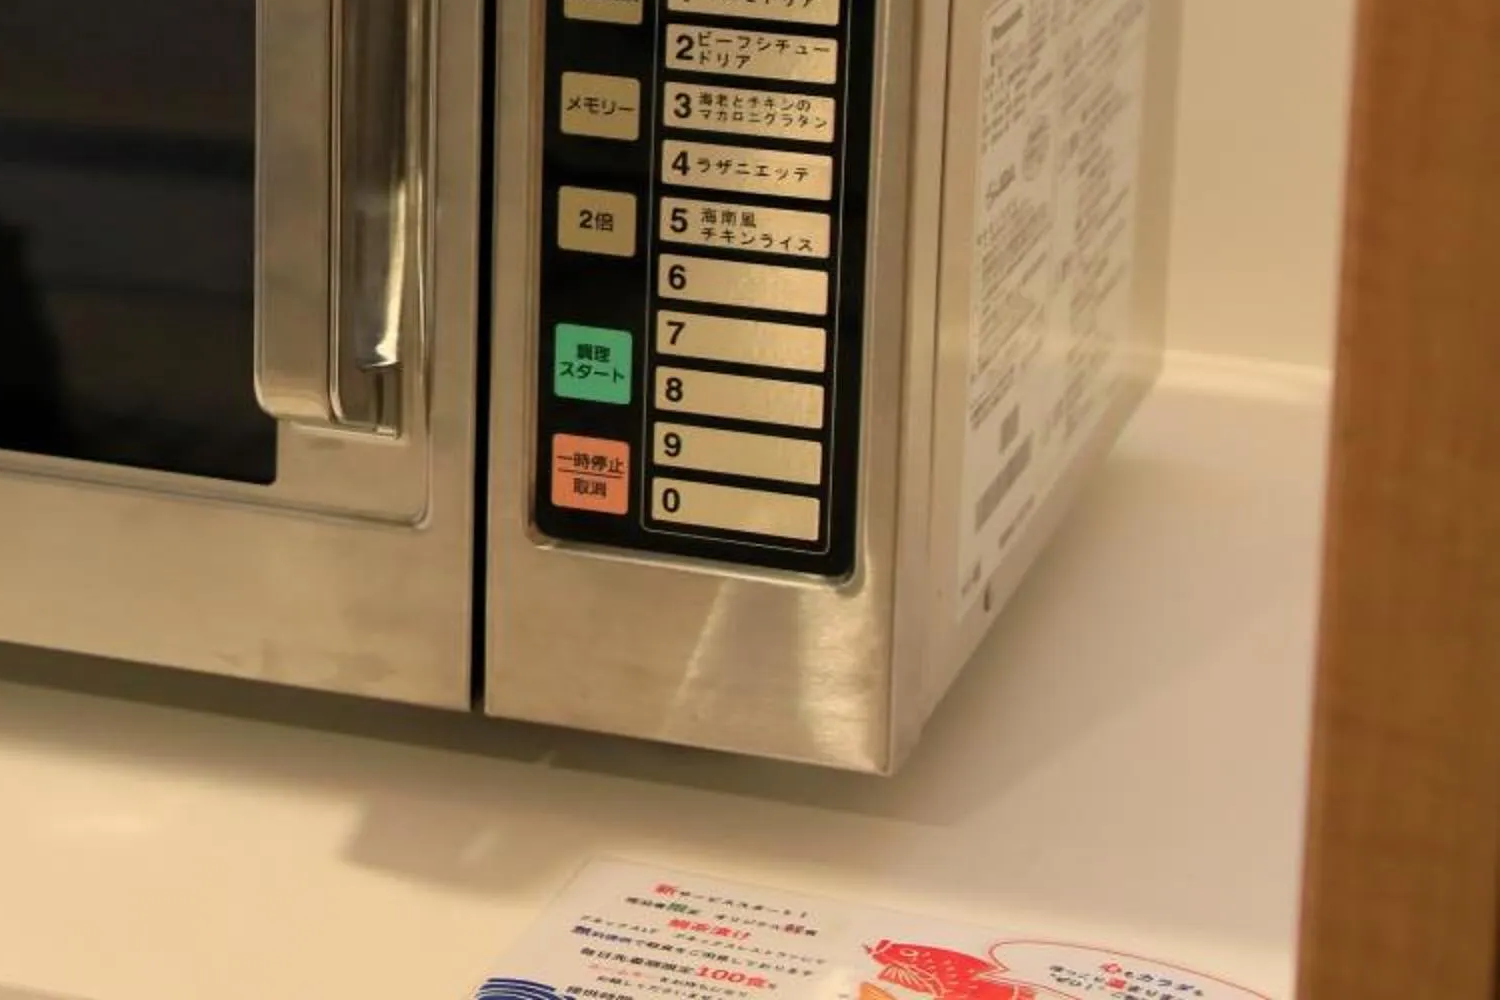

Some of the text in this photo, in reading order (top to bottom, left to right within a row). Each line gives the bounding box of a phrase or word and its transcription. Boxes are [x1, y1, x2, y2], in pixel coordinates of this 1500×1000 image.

[675, 31, 831, 61] 2 ビーフシチュー
[699, 51, 751, 68] ドリア
[566, 96, 636, 116] メモリー
[673, 92, 692, 119] 3
[699, 109, 828, 130] マカロニグラタン
[672, 151, 809, 182] 4 ラザニエッテ
[579, 209, 614, 232] 2倍
[670, 207, 757, 233] 5 海南風
[700, 226, 814, 253] チキンライス
[667, 264, 687, 290] 6
[666, 321, 685, 345] 7
[558, 361, 625, 384] スタート
[665, 377, 684, 403] 8
[663, 432, 682, 458] 9
[557, 451, 624, 473] 一時停止
[661, 487, 681, 514] 0
